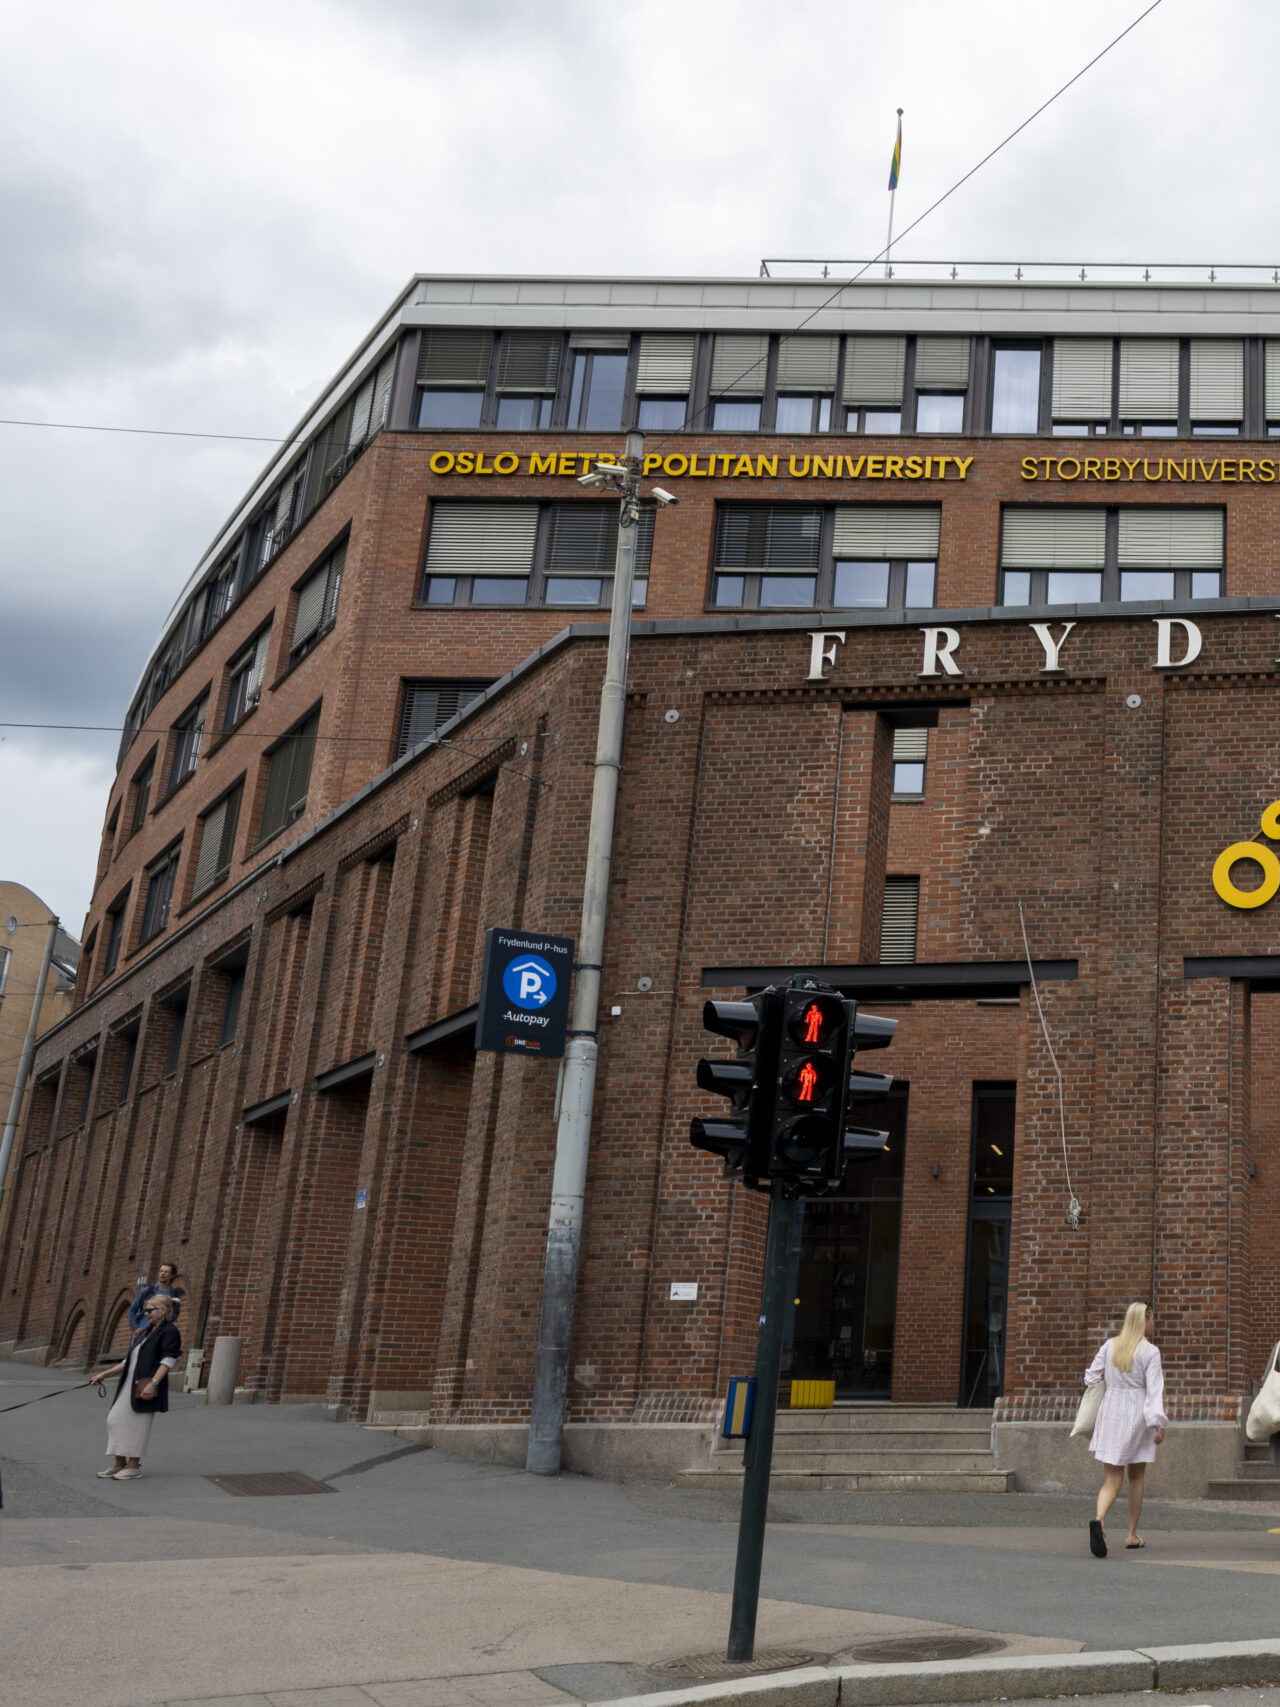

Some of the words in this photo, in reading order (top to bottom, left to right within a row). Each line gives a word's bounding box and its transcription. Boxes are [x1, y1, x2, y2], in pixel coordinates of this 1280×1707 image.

[429, 451, 519, 475] OSLO
[529, 452, 778, 478] METRPOLITAN
[788, 454, 975, 480] UNIVERSITY
[498, 936, 543, 951] Frydenlund
[544, 943, 568, 954] P-hus
[502, 1011, 550, 1027] Autopay
